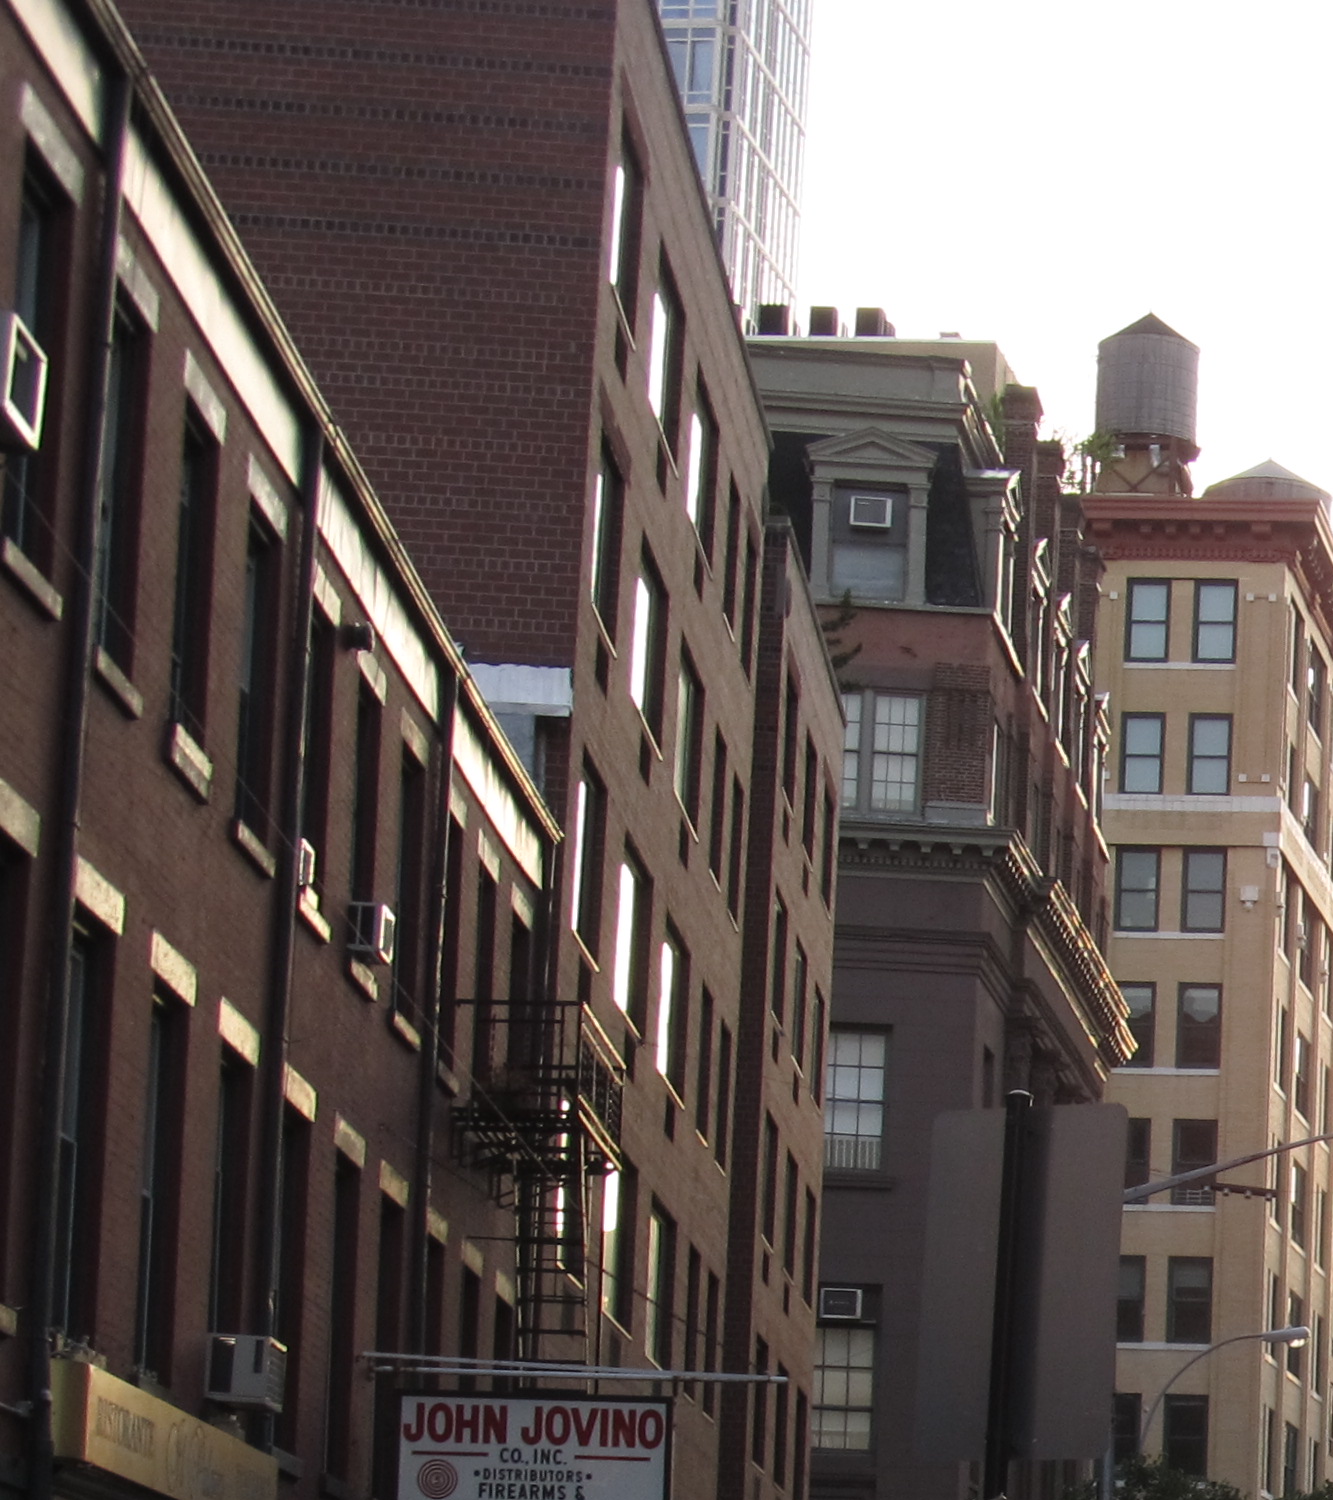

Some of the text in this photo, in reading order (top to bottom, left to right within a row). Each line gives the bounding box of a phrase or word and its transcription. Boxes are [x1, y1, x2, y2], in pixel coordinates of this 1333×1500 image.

[403, 1402, 664, 1449] JOHN JOVINO
[478, 1482, 586, 1500] FIREARMS &
